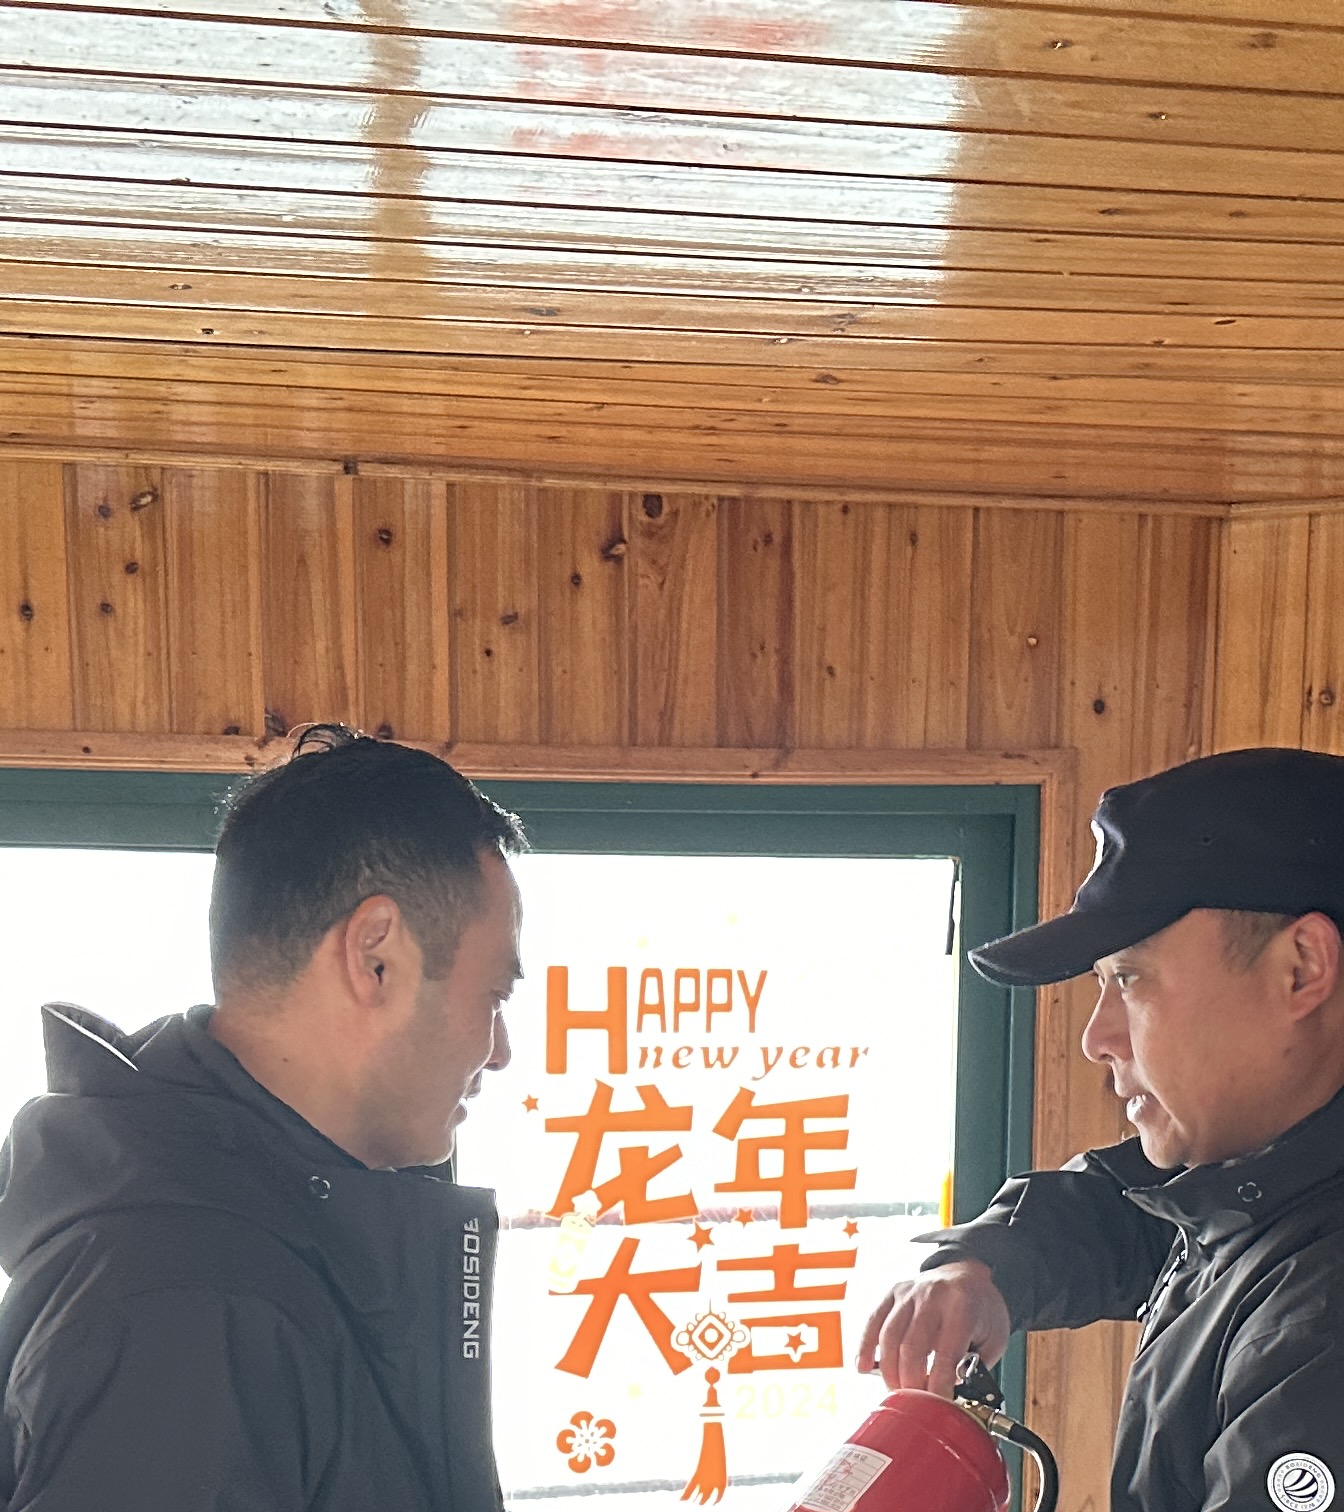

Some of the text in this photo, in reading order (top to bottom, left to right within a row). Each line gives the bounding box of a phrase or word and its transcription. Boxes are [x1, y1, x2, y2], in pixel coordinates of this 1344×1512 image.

[545, 965, 768, 1075] HAPPY
[637, 1045, 870, 1081] new year
[544, 1078, 859, 1230] 龙年
[548, 1237, 859, 1380] 大吉
[735, 1382, 839, 1420] 2024
